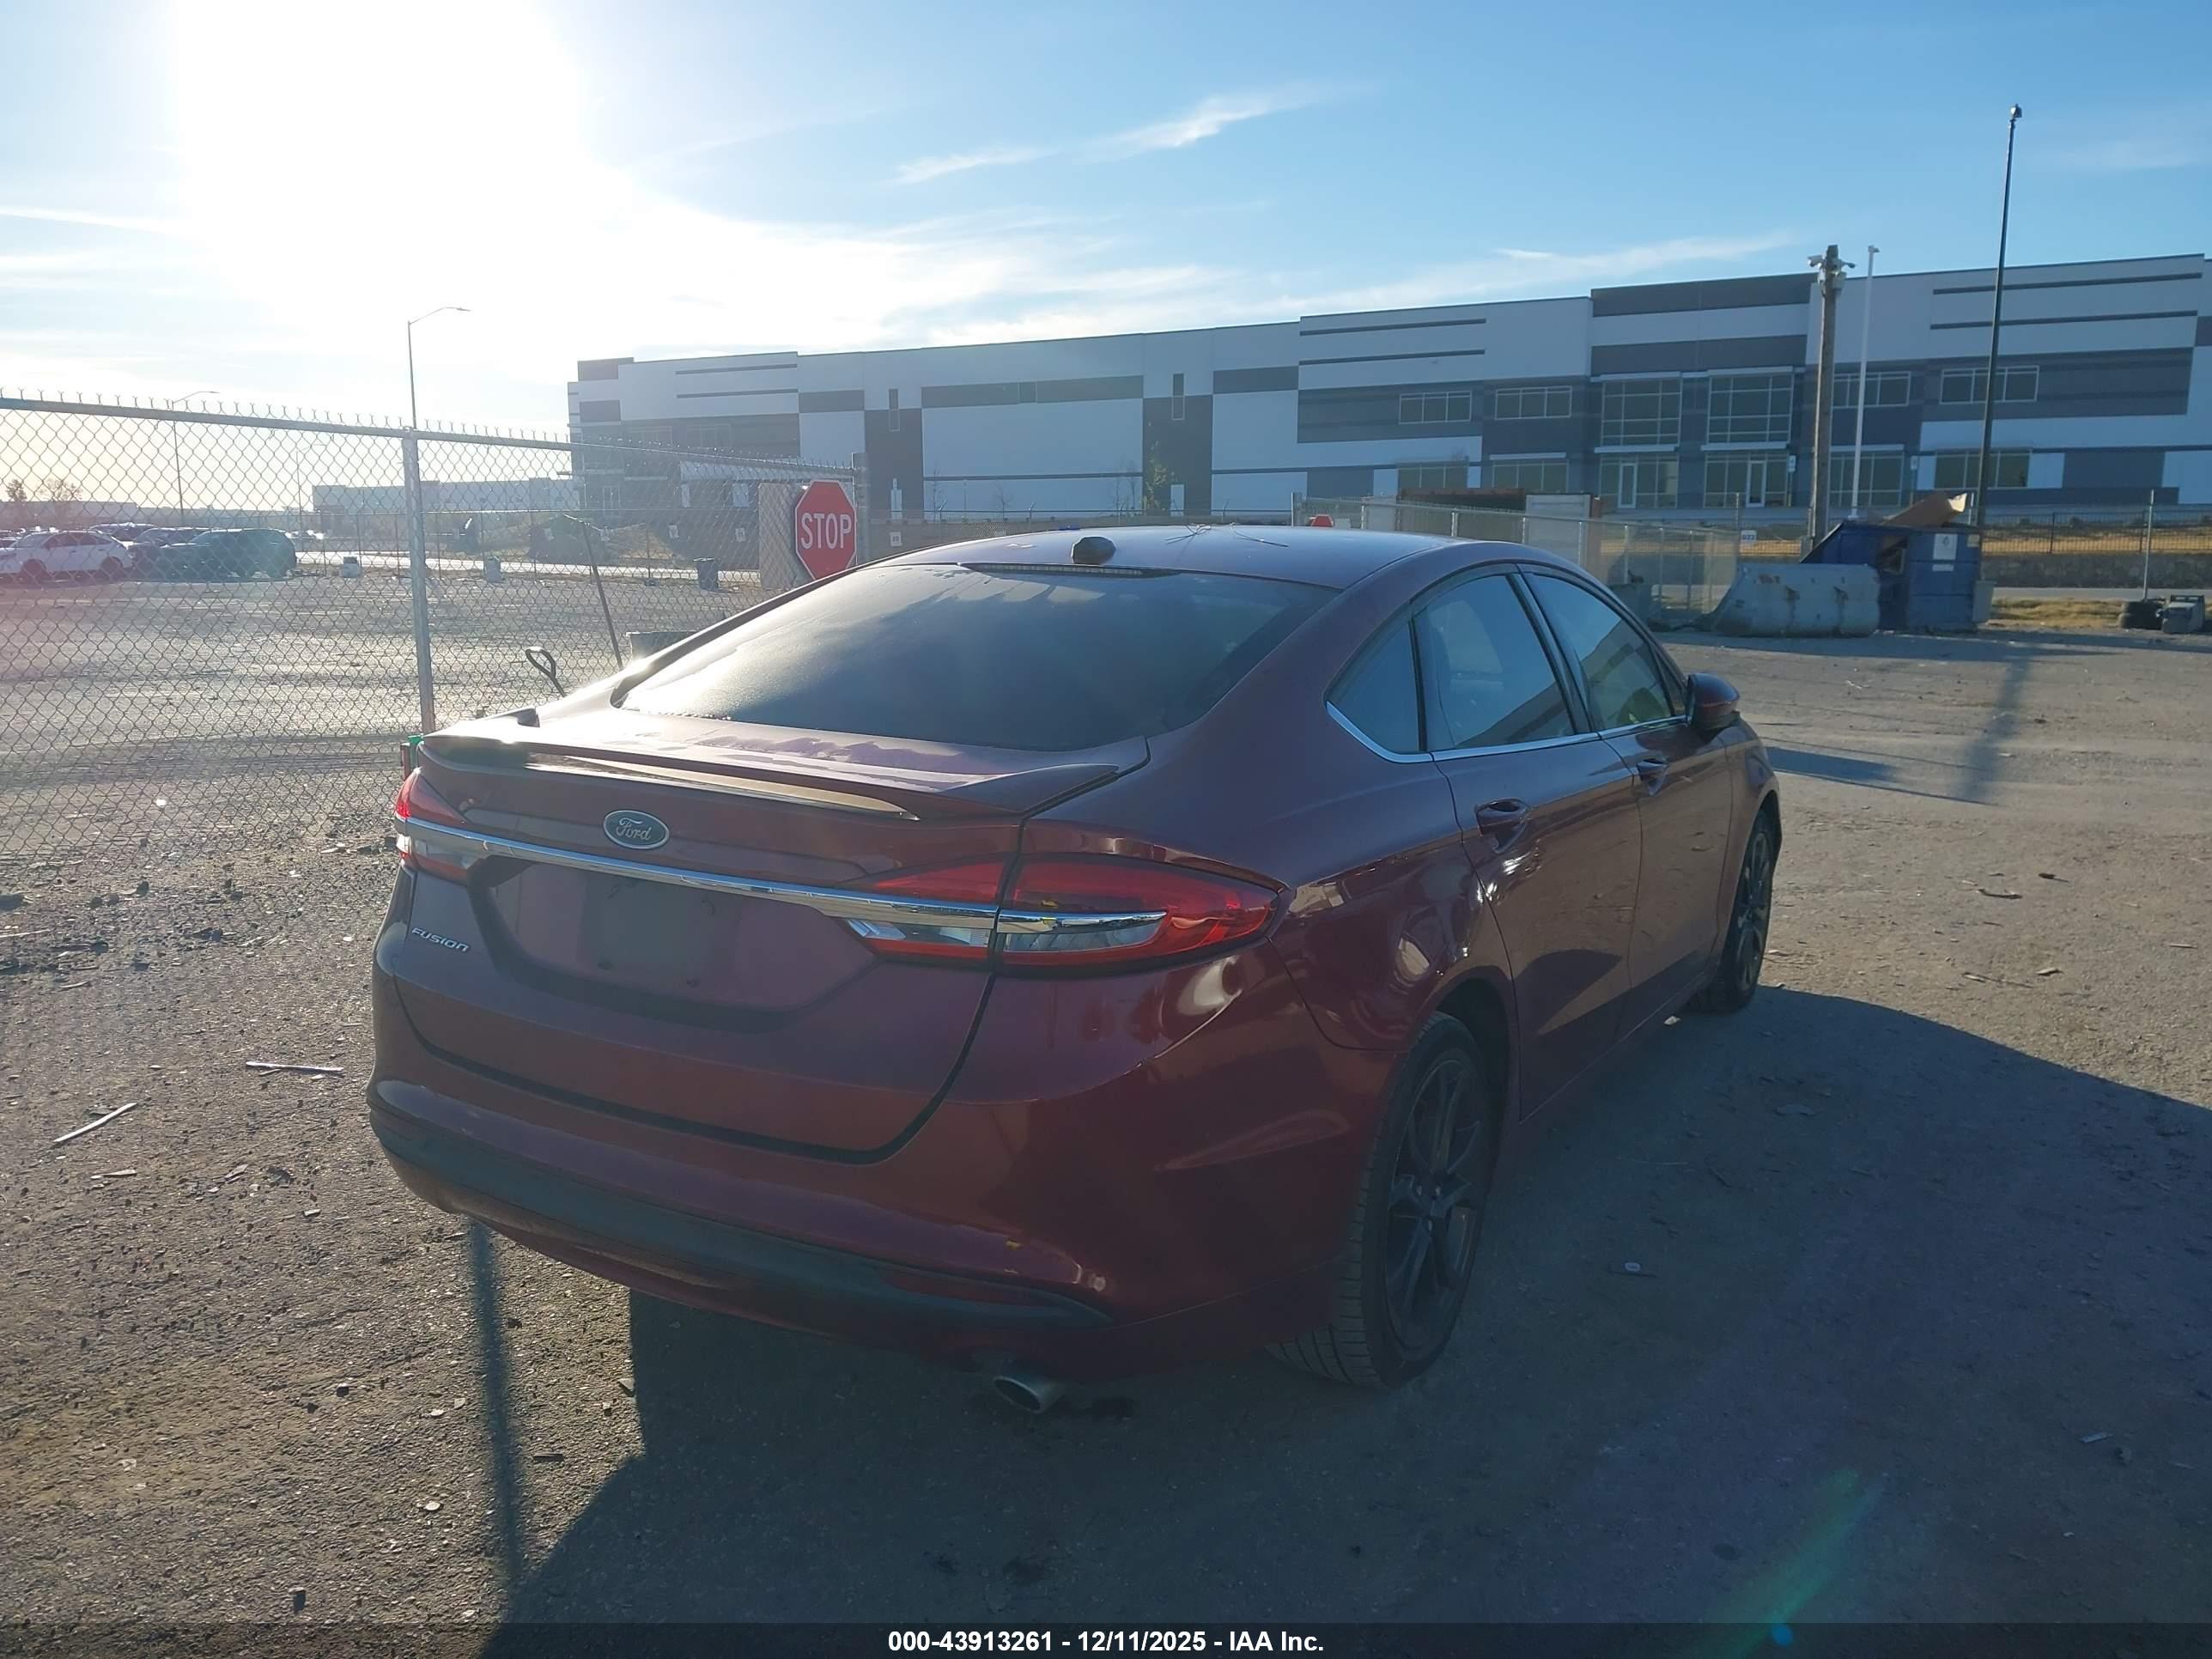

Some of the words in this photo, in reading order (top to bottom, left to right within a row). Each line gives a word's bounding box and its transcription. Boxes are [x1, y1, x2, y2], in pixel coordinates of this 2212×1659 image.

[800, 513, 852, 550] STOP
[616, 817, 652, 840] Ford
[412, 927, 469, 951] FUSION
